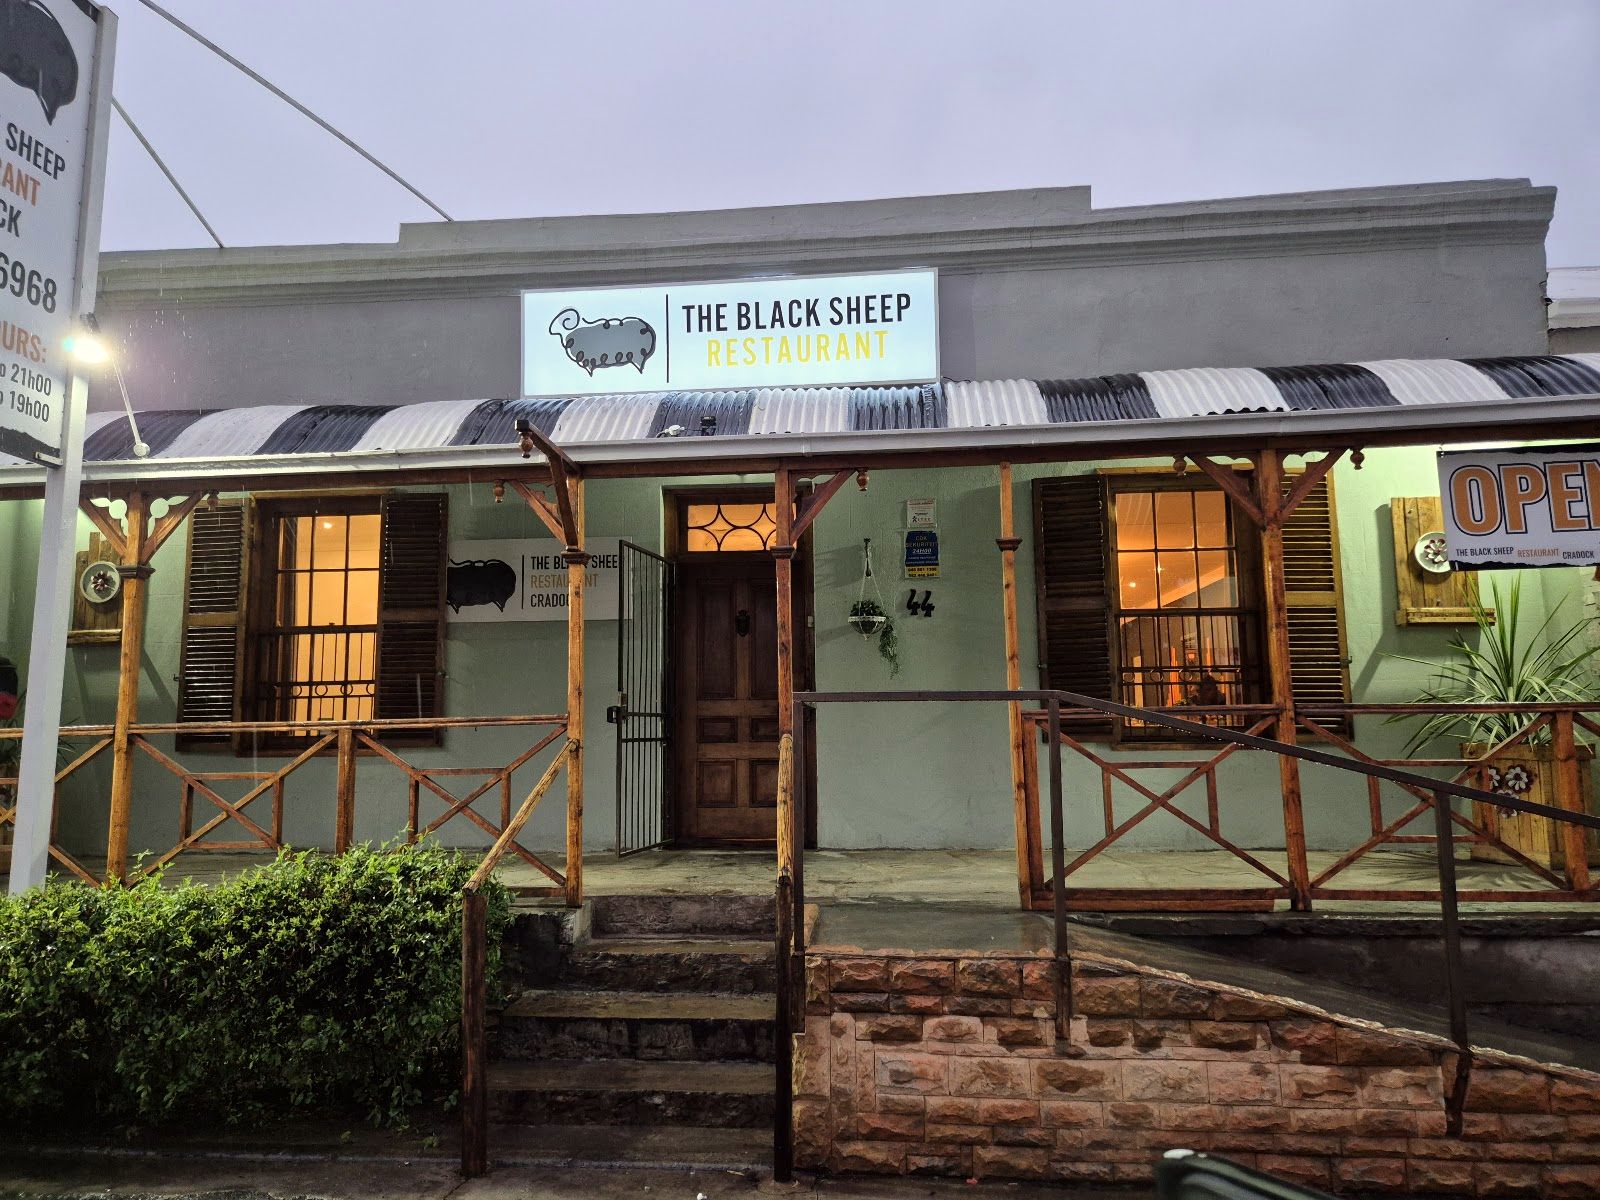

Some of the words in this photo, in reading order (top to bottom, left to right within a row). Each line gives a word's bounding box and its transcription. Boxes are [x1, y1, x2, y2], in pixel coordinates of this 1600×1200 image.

[5, 122, 66, 180] SHEEP
[0, 158, 41, 207] ANT
[681, 303, 728, 333] THE
[737, 298, 821, 331] BLACK
[829, 293, 911, 325] SHEEP
[0, 320, 47, 364] URS:
[707, 330, 889, 367] RESTAURANT
[10, 363, 52, 397] 21h00
[9, 390, 50, 423] 19h00
[530, 556, 550, 570] THE
[591, 554, 618, 569] SHEE
[1456, 548, 1469, 557] THE
[1470, 548, 1492, 557] BLACK
[1494, 546, 1514, 556] SHEEP
[1517, 548, 1560, 558] RESTAURANT
[1562, 550, 1595, 559] CRADOCK
[530, 573, 600, 589] RESTAUNT
[530, 593, 570, 608] CRADO
[906, 589, 936, 618] 44
